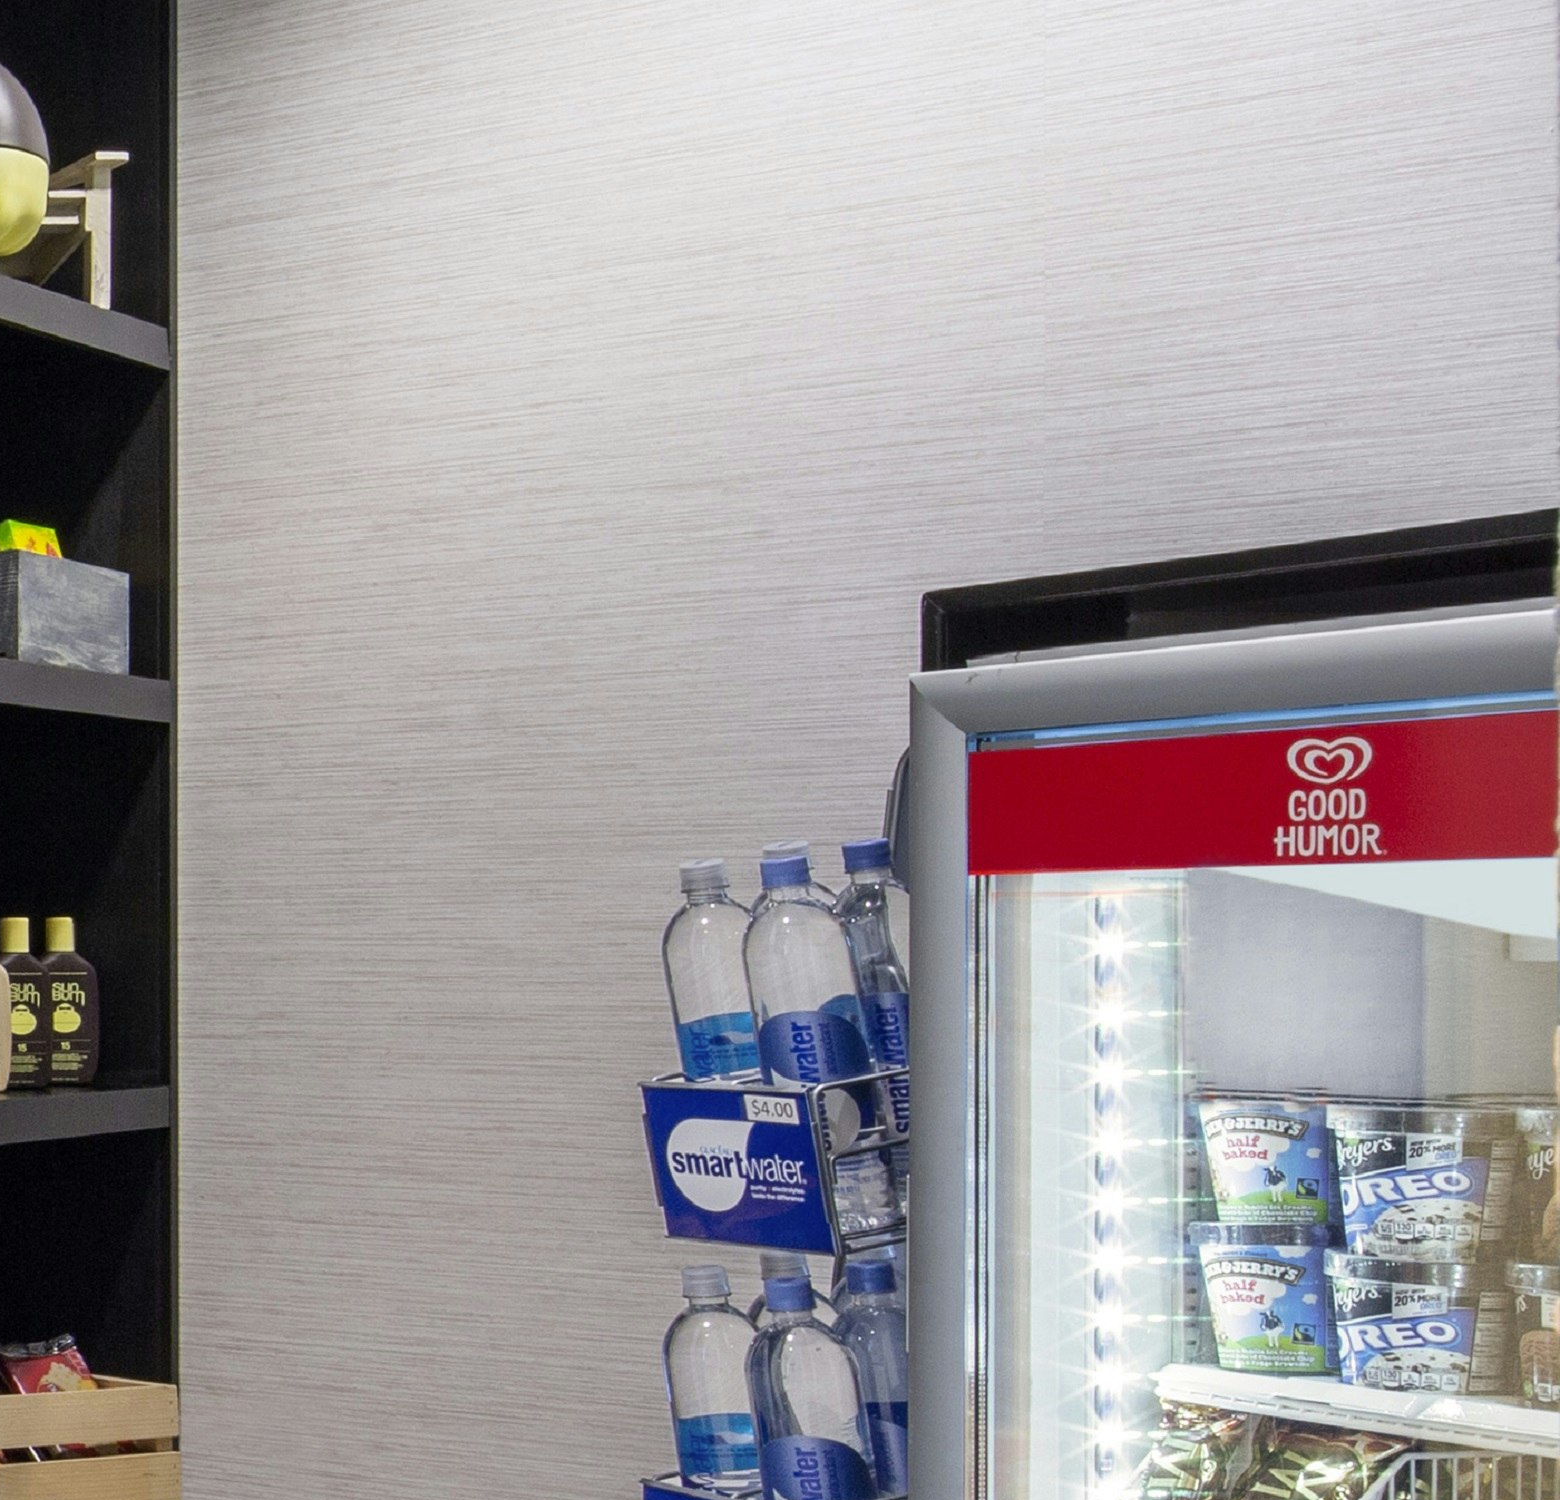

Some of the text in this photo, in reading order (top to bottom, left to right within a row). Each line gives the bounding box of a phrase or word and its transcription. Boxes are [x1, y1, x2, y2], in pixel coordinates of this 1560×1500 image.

[1288, 788, 1366, 822] GOOD
[1275, 823, 1381, 857] HUMOR
[751, 1099, 794, 1119] $4.00
[1226, 1135, 1260, 1148] half
[1222, 1147, 1268, 1161] baked
[672, 1150, 804, 1186] smartwater
[1340, 1170, 1471, 1217] OREO
[1222, 1279, 1257, 1293] half
[1219, 1292, 1265, 1306] baked
